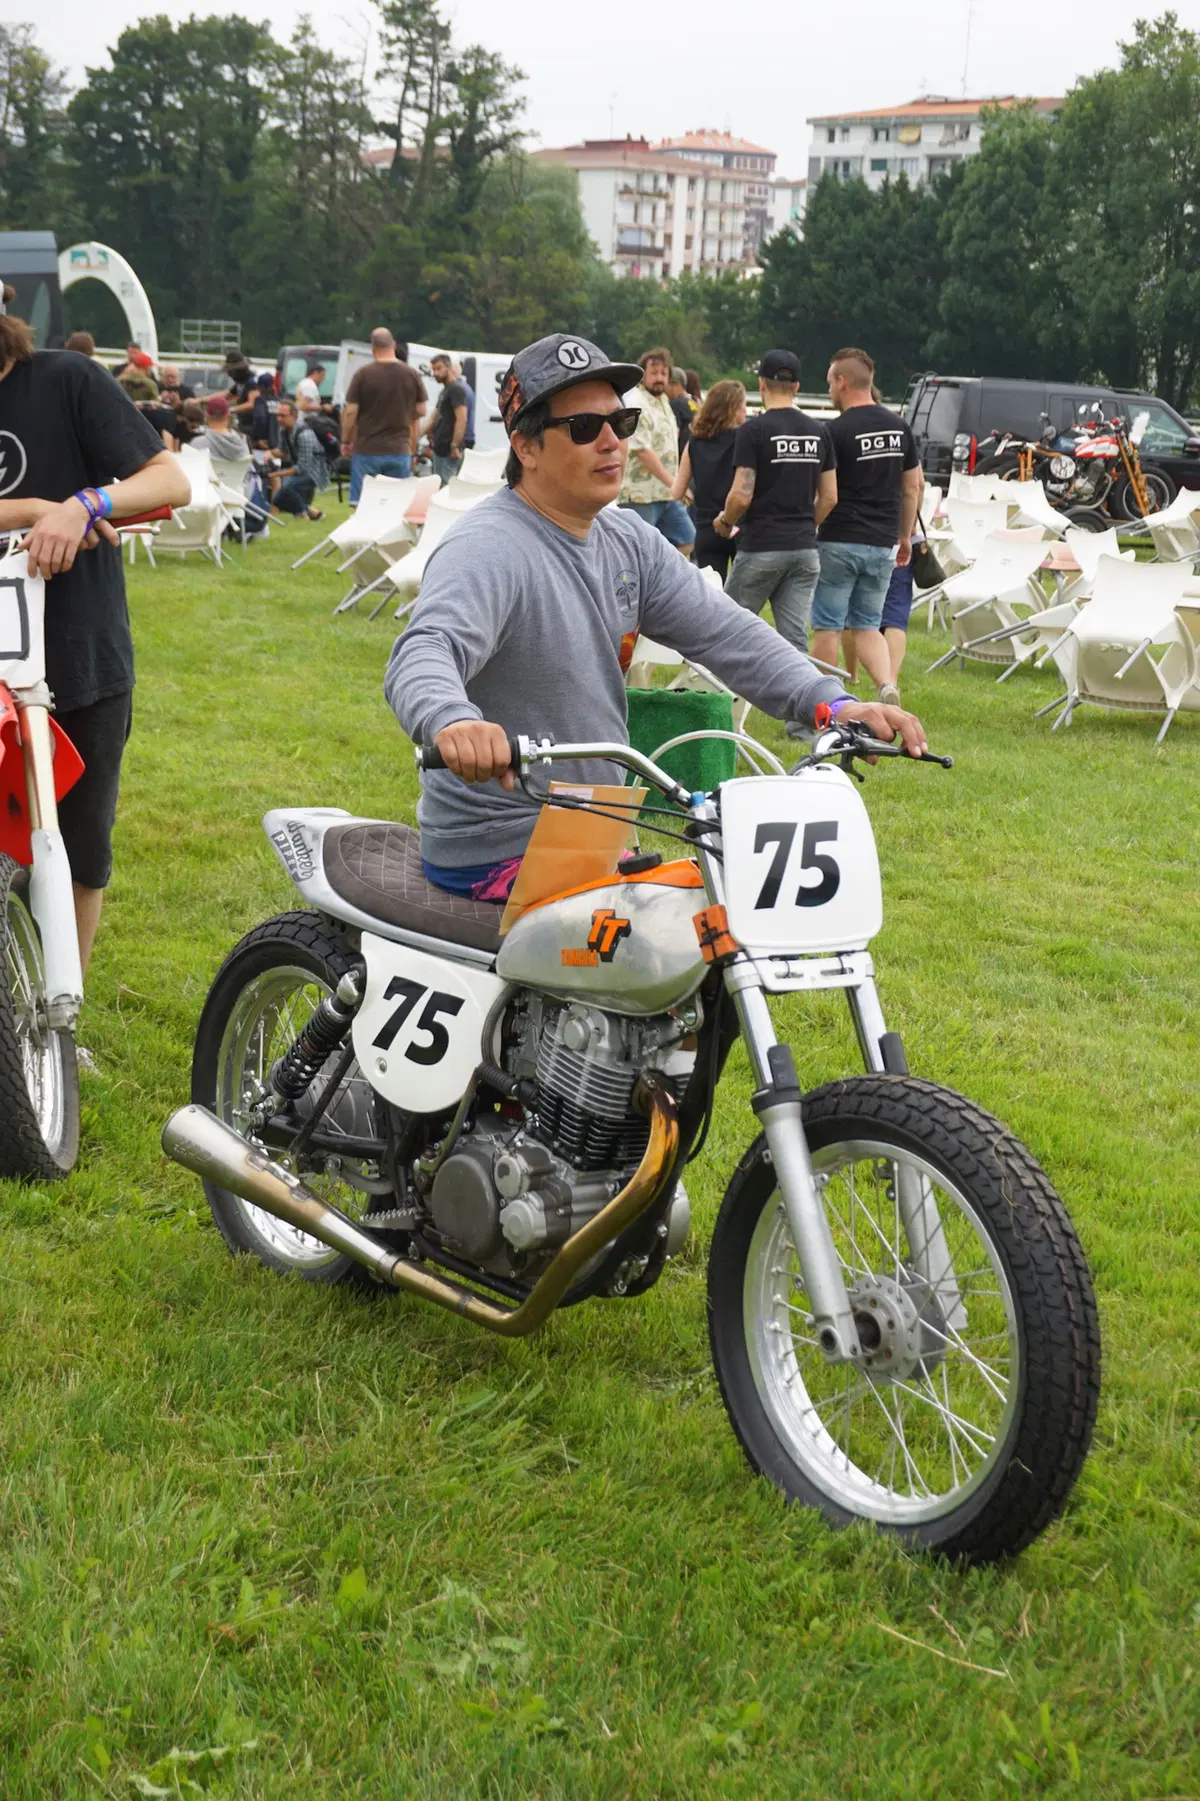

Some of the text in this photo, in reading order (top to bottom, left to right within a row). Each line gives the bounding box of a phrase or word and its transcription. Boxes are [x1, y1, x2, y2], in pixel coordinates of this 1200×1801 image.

[776, 440, 818, 453] DGM
[860, 435, 901, 450] DGM
[273, 831, 298, 876] PIPES
[287, 820, 317, 879] Wanker
[753, 821, 840, 910] 75
[587, 909, 632, 962] TT
[371, 975, 466, 1066] 75
